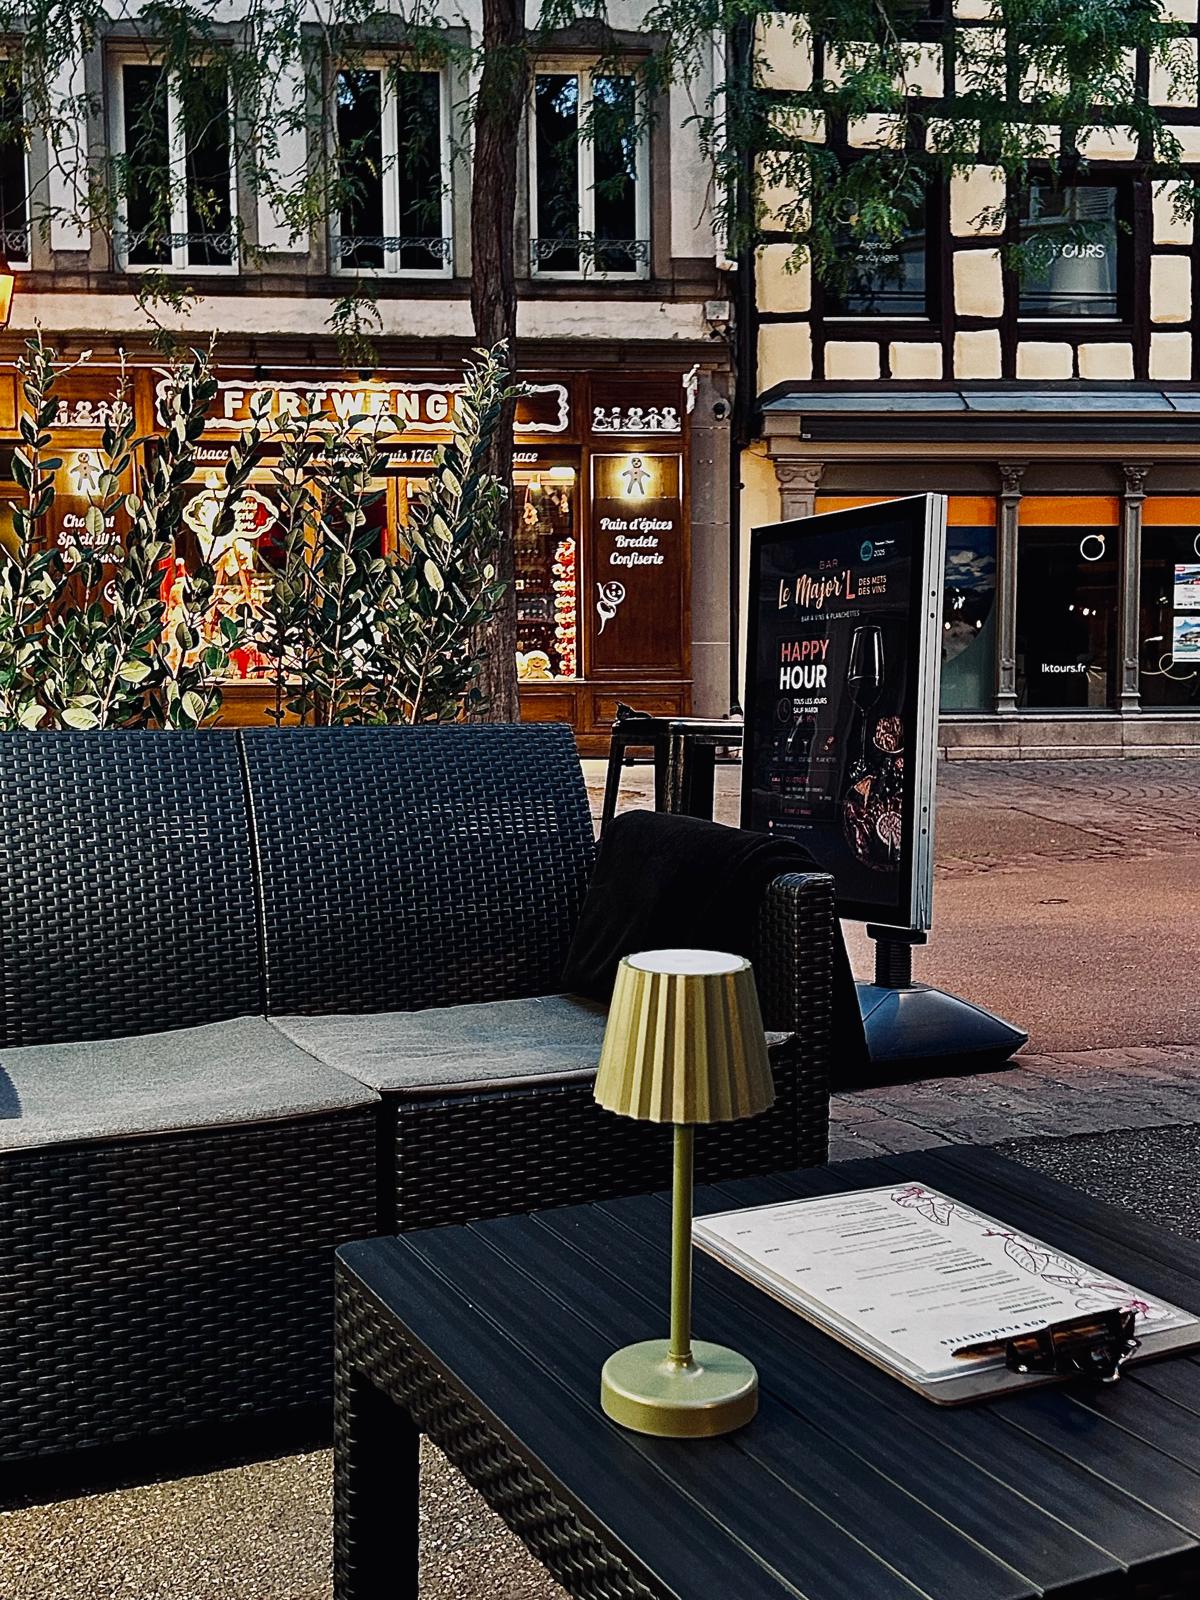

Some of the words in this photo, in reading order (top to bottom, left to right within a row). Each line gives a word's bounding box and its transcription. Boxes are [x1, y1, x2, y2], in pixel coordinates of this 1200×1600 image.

[600, 517, 627, 531] Pain
[629, 517, 673, 533] d'épices
[615, 535, 659, 548] Bredele
[610, 552, 664, 568] Confiserie
[819, 558, 839, 570] BAR
[858, 577, 871, 586] DES
[871, 575, 887, 585] METS
[778, 578, 792, 610] Le
[795, 570, 856, 610] Major'L
[858, 586, 871, 596] DES
[872, 585, 887, 594] VINS
[781, 639, 830, 663] HAPPY
[779, 664, 828, 690] HOUR
[1024, 1319, 1047, 1328] NOS
[940, 1324, 1021, 1345] PLANCHETTES
